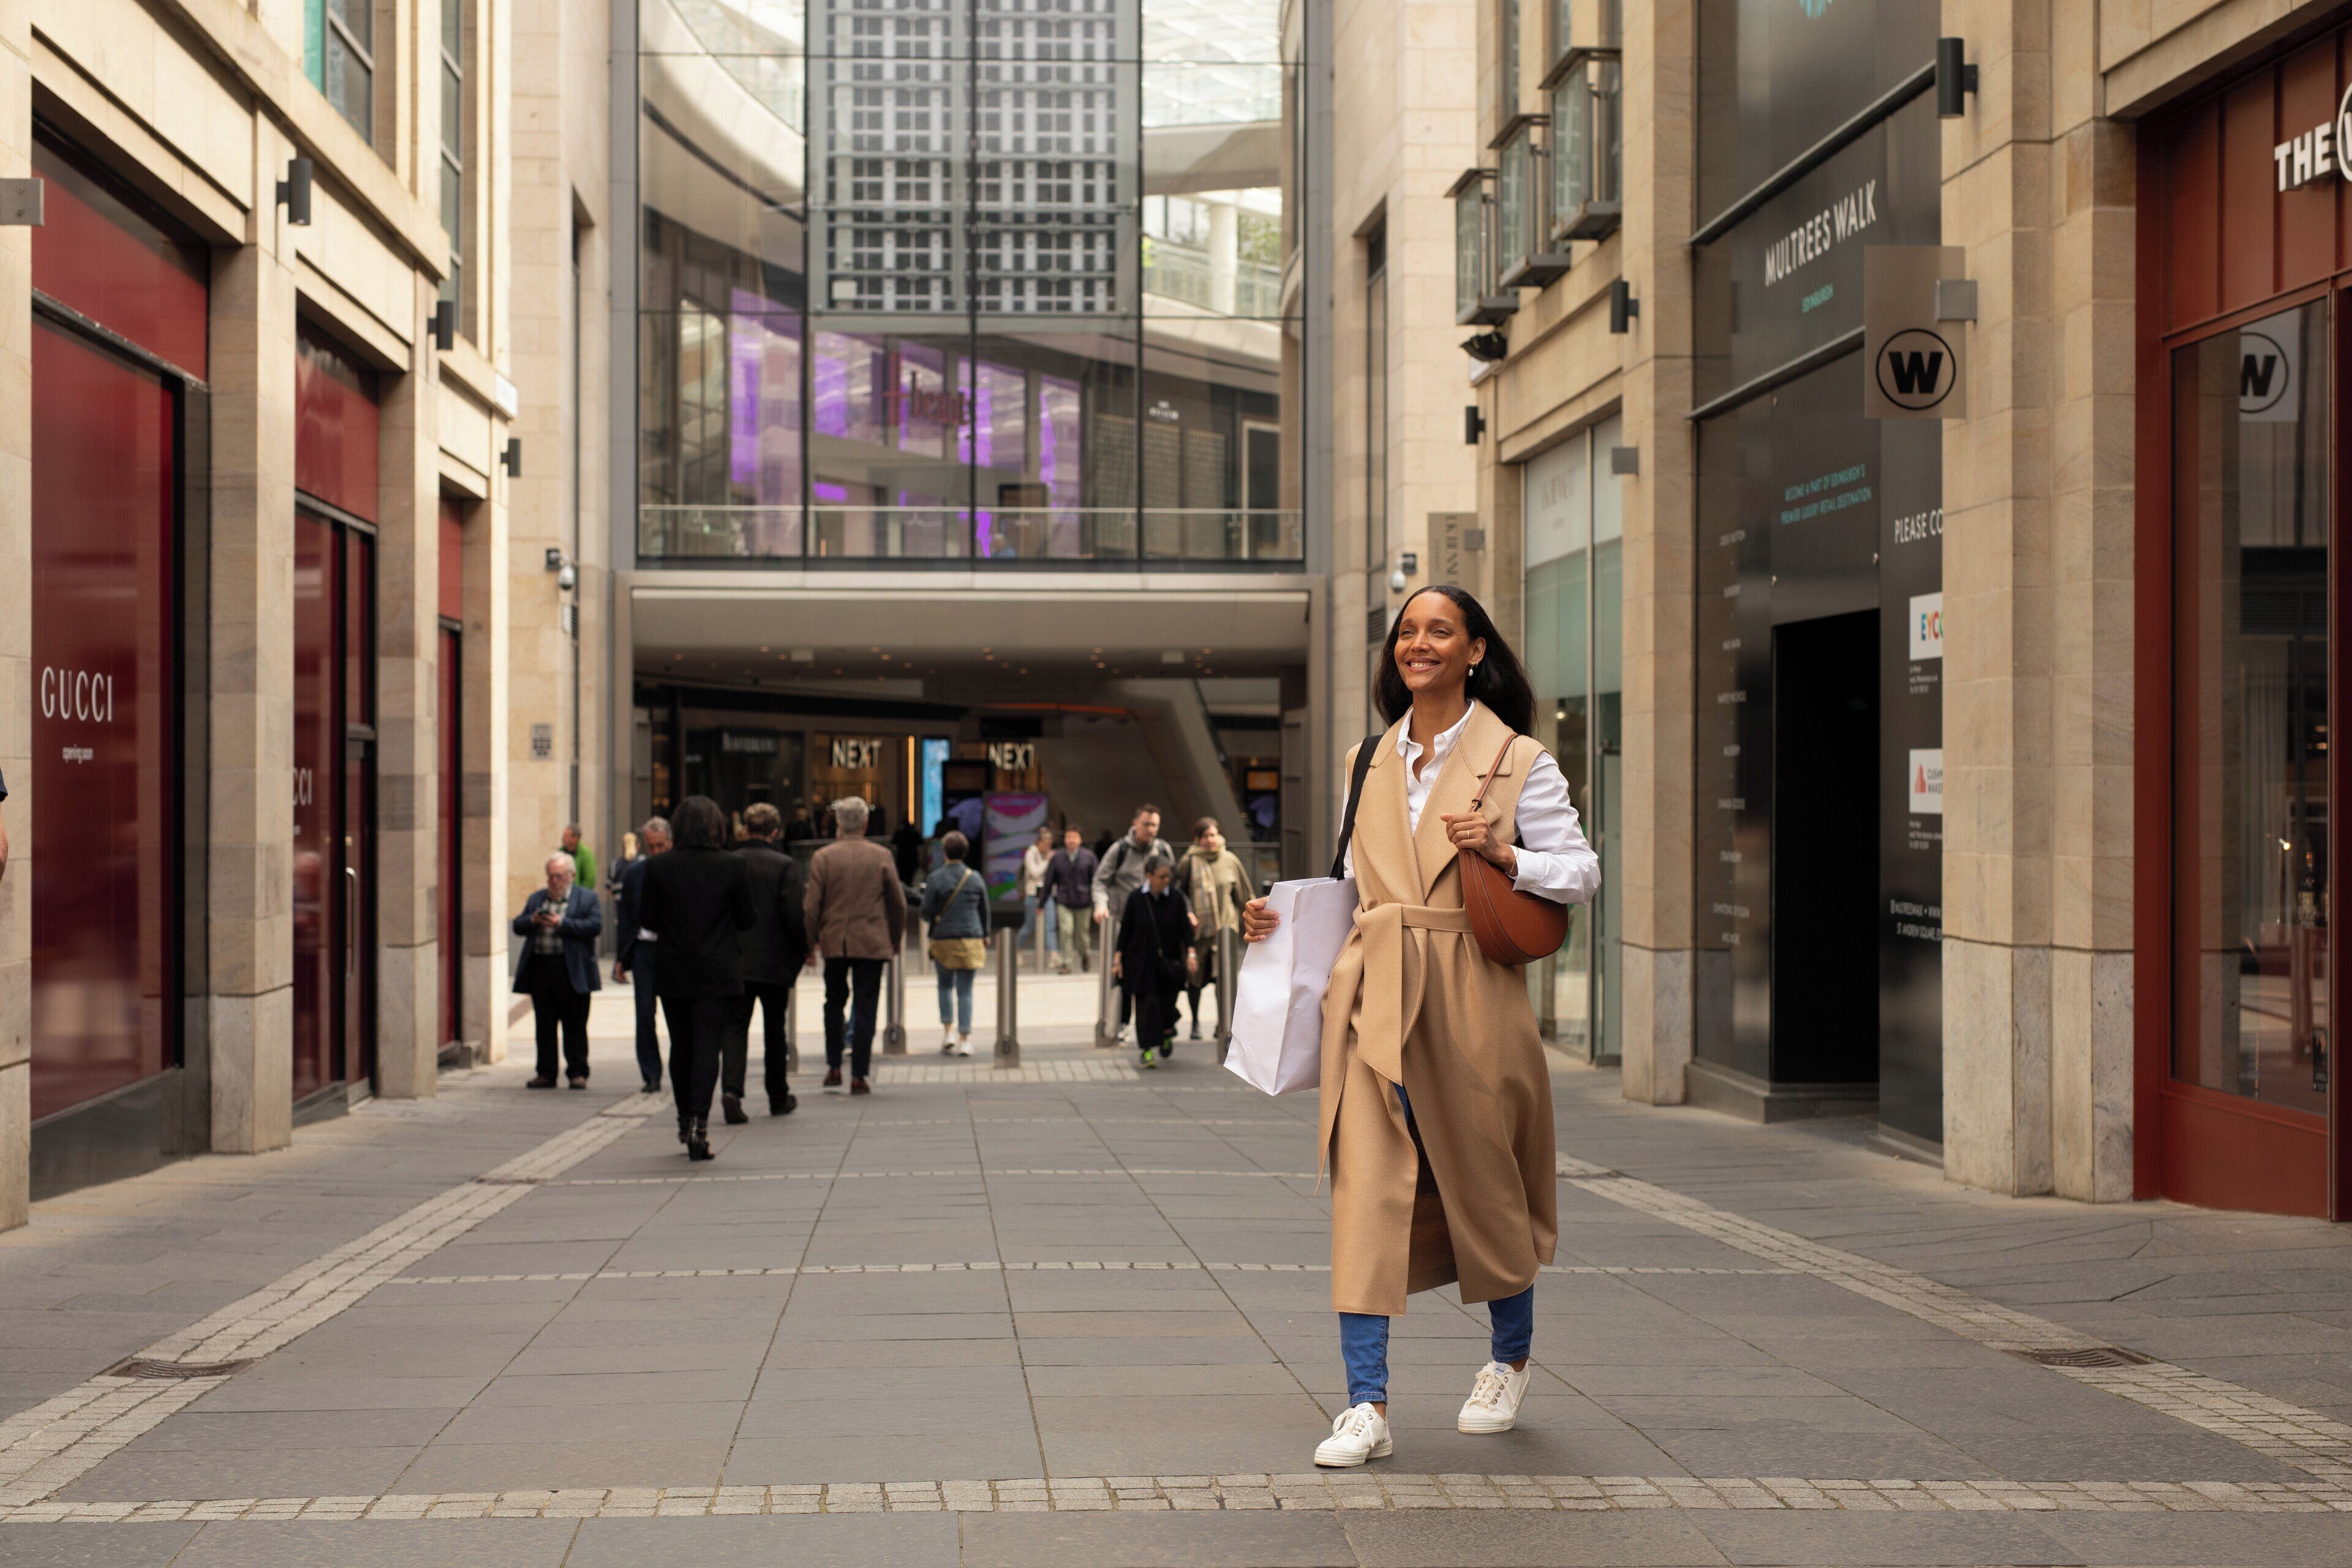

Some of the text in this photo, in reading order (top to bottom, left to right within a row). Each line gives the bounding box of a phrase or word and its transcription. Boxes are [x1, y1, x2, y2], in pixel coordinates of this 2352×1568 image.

[2274, 121, 2331, 192] THE
[1765, 178, 1877, 287] MULTREES WALK
[1894, 512, 1927, 545] PLEASE
[41, 666, 112, 723] GUCCI
[831, 738, 882, 769] NEXT
[989, 742, 1035, 771] NEXT
